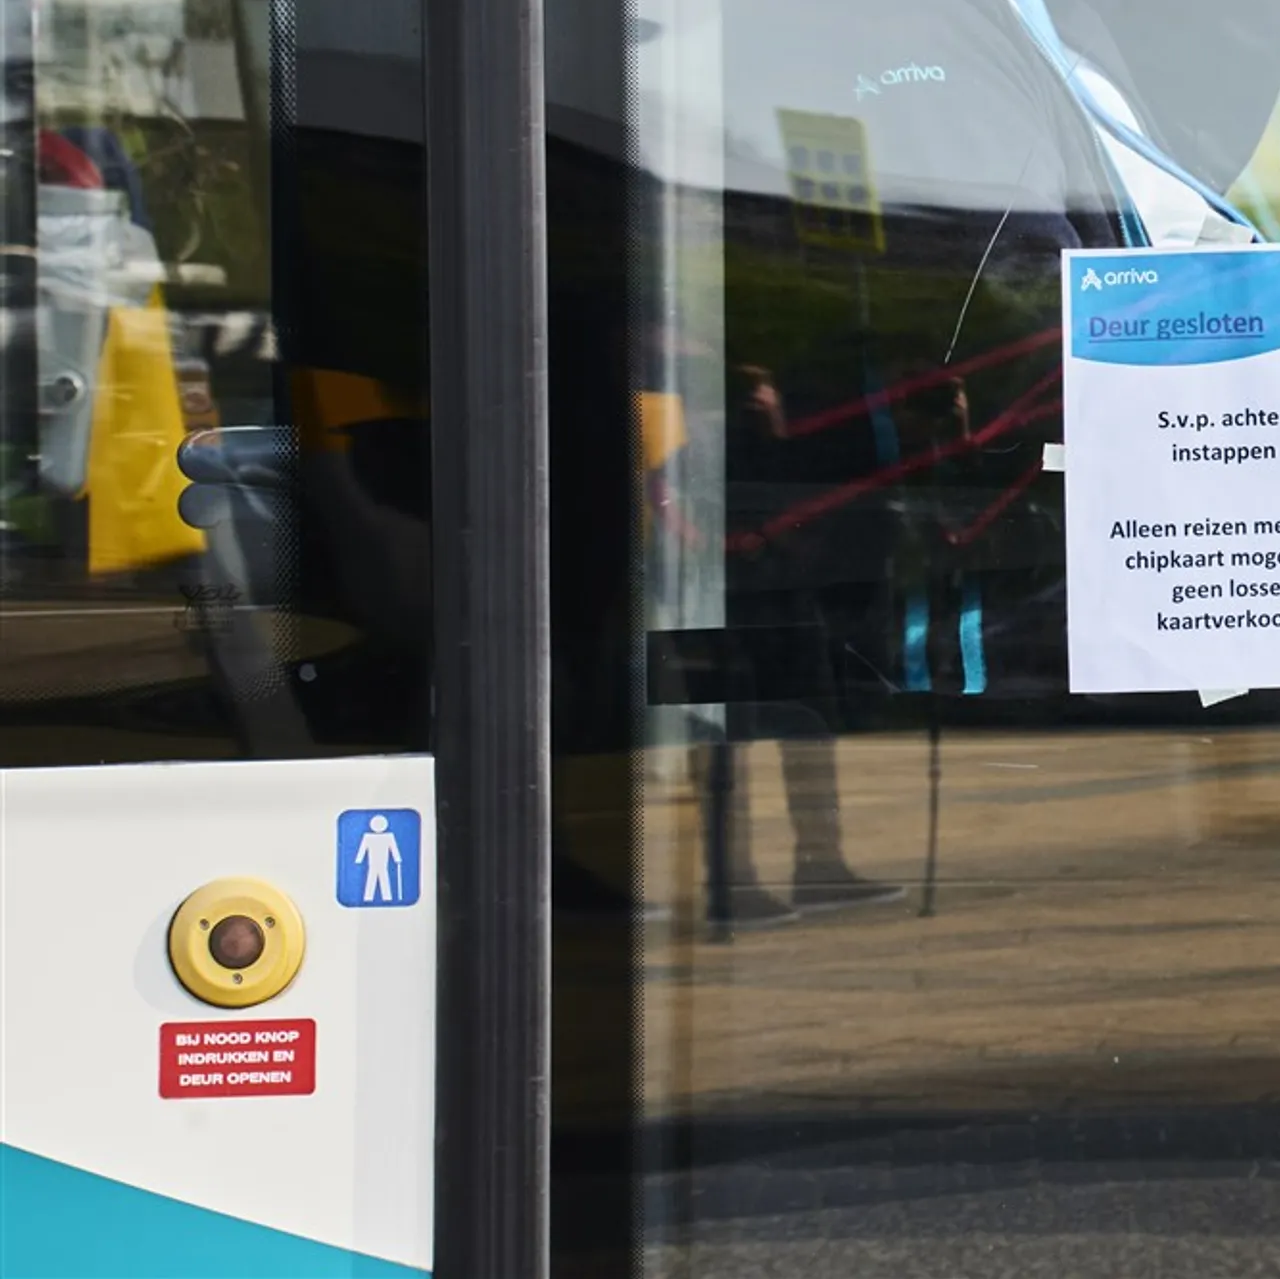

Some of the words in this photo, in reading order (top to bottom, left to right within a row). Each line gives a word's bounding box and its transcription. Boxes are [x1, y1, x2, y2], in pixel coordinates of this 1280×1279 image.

[880, 61, 946, 85] arriva
[1103, 267, 1159, 286] arriva
[1089, 315, 1151, 339] Deur
[1156, 312, 1265, 341] gesloten
[1158, 411, 1215, 432] S.v.p.
[1172, 443, 1277, 465] instappen
[1110, 519, 1177, 539] Alleen
[1184, 517, 1247, 537] reizen
[1125, 549, 1225, 572] chipkaart
[1172, 584, 1223, 604] geen
[175, 1033, 200, 1046] BIJ
[203, 1032, 251, 1045] NOOD
[254, 1030, 300, 1044] KNOP
[178, 1051, 269, 1066] INDRUKKEN
[272, 1049, 295, 1062] EN
[179, 1073, 224, 1087] DEUR
[226, 1071, 292, 1085] OPENEN
